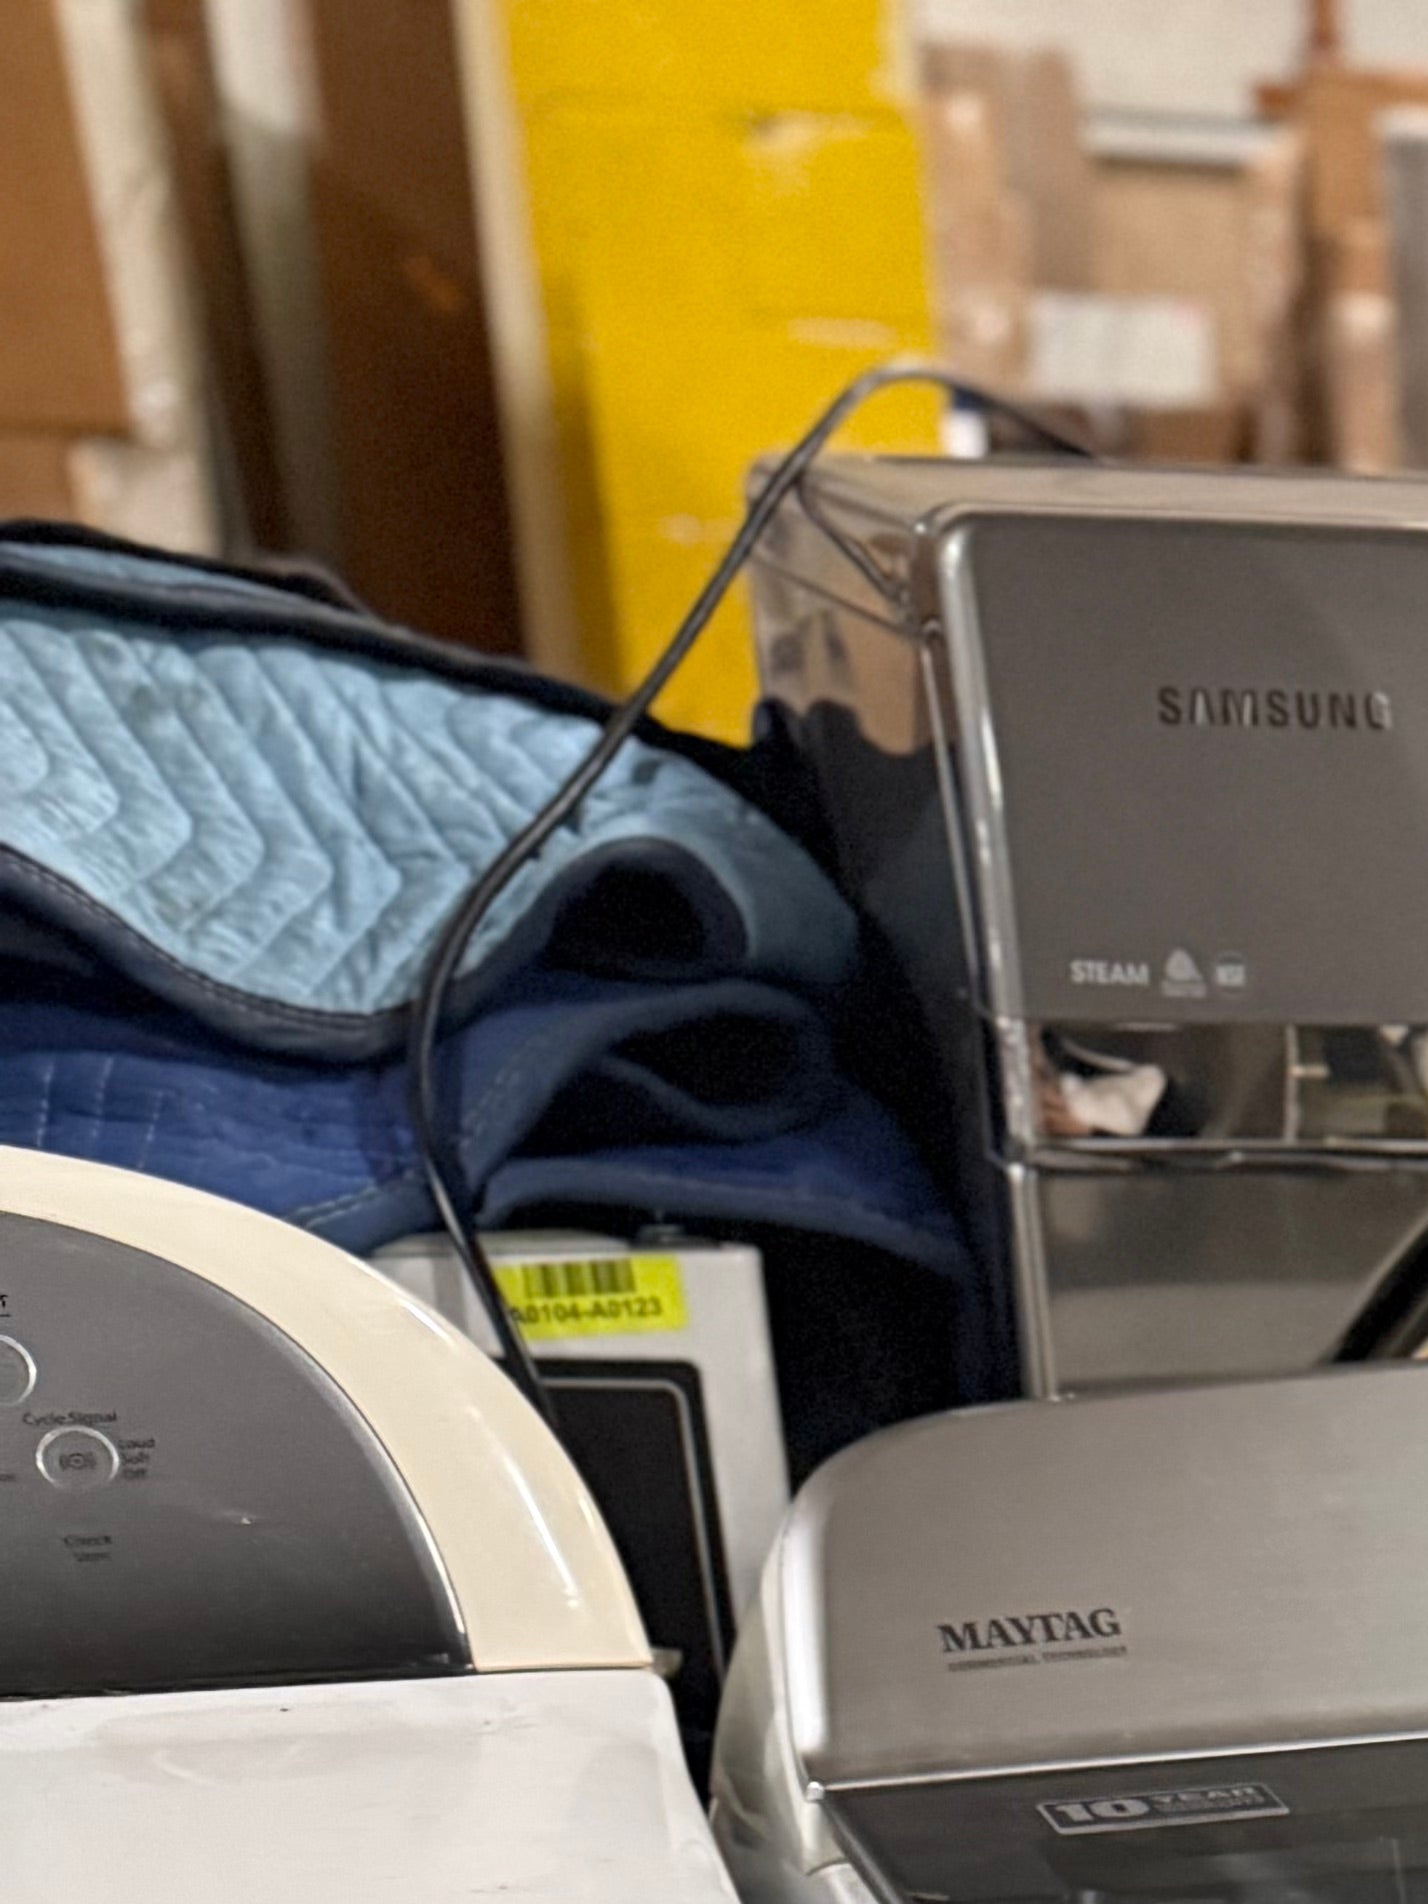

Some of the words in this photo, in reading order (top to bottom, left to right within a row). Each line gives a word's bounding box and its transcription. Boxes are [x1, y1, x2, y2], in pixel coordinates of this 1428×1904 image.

[1157, 686, 1392, 730] SAMSUNG
[1070, 959, 1150, 987] STEAM
[22, 1412, 66, 1427] Cycle
[67, 1410, 118, 1426] Signal
[936, 1608, 1122, 1653] MAYTAG
[1053, 1798, 1151, 1824] 10
